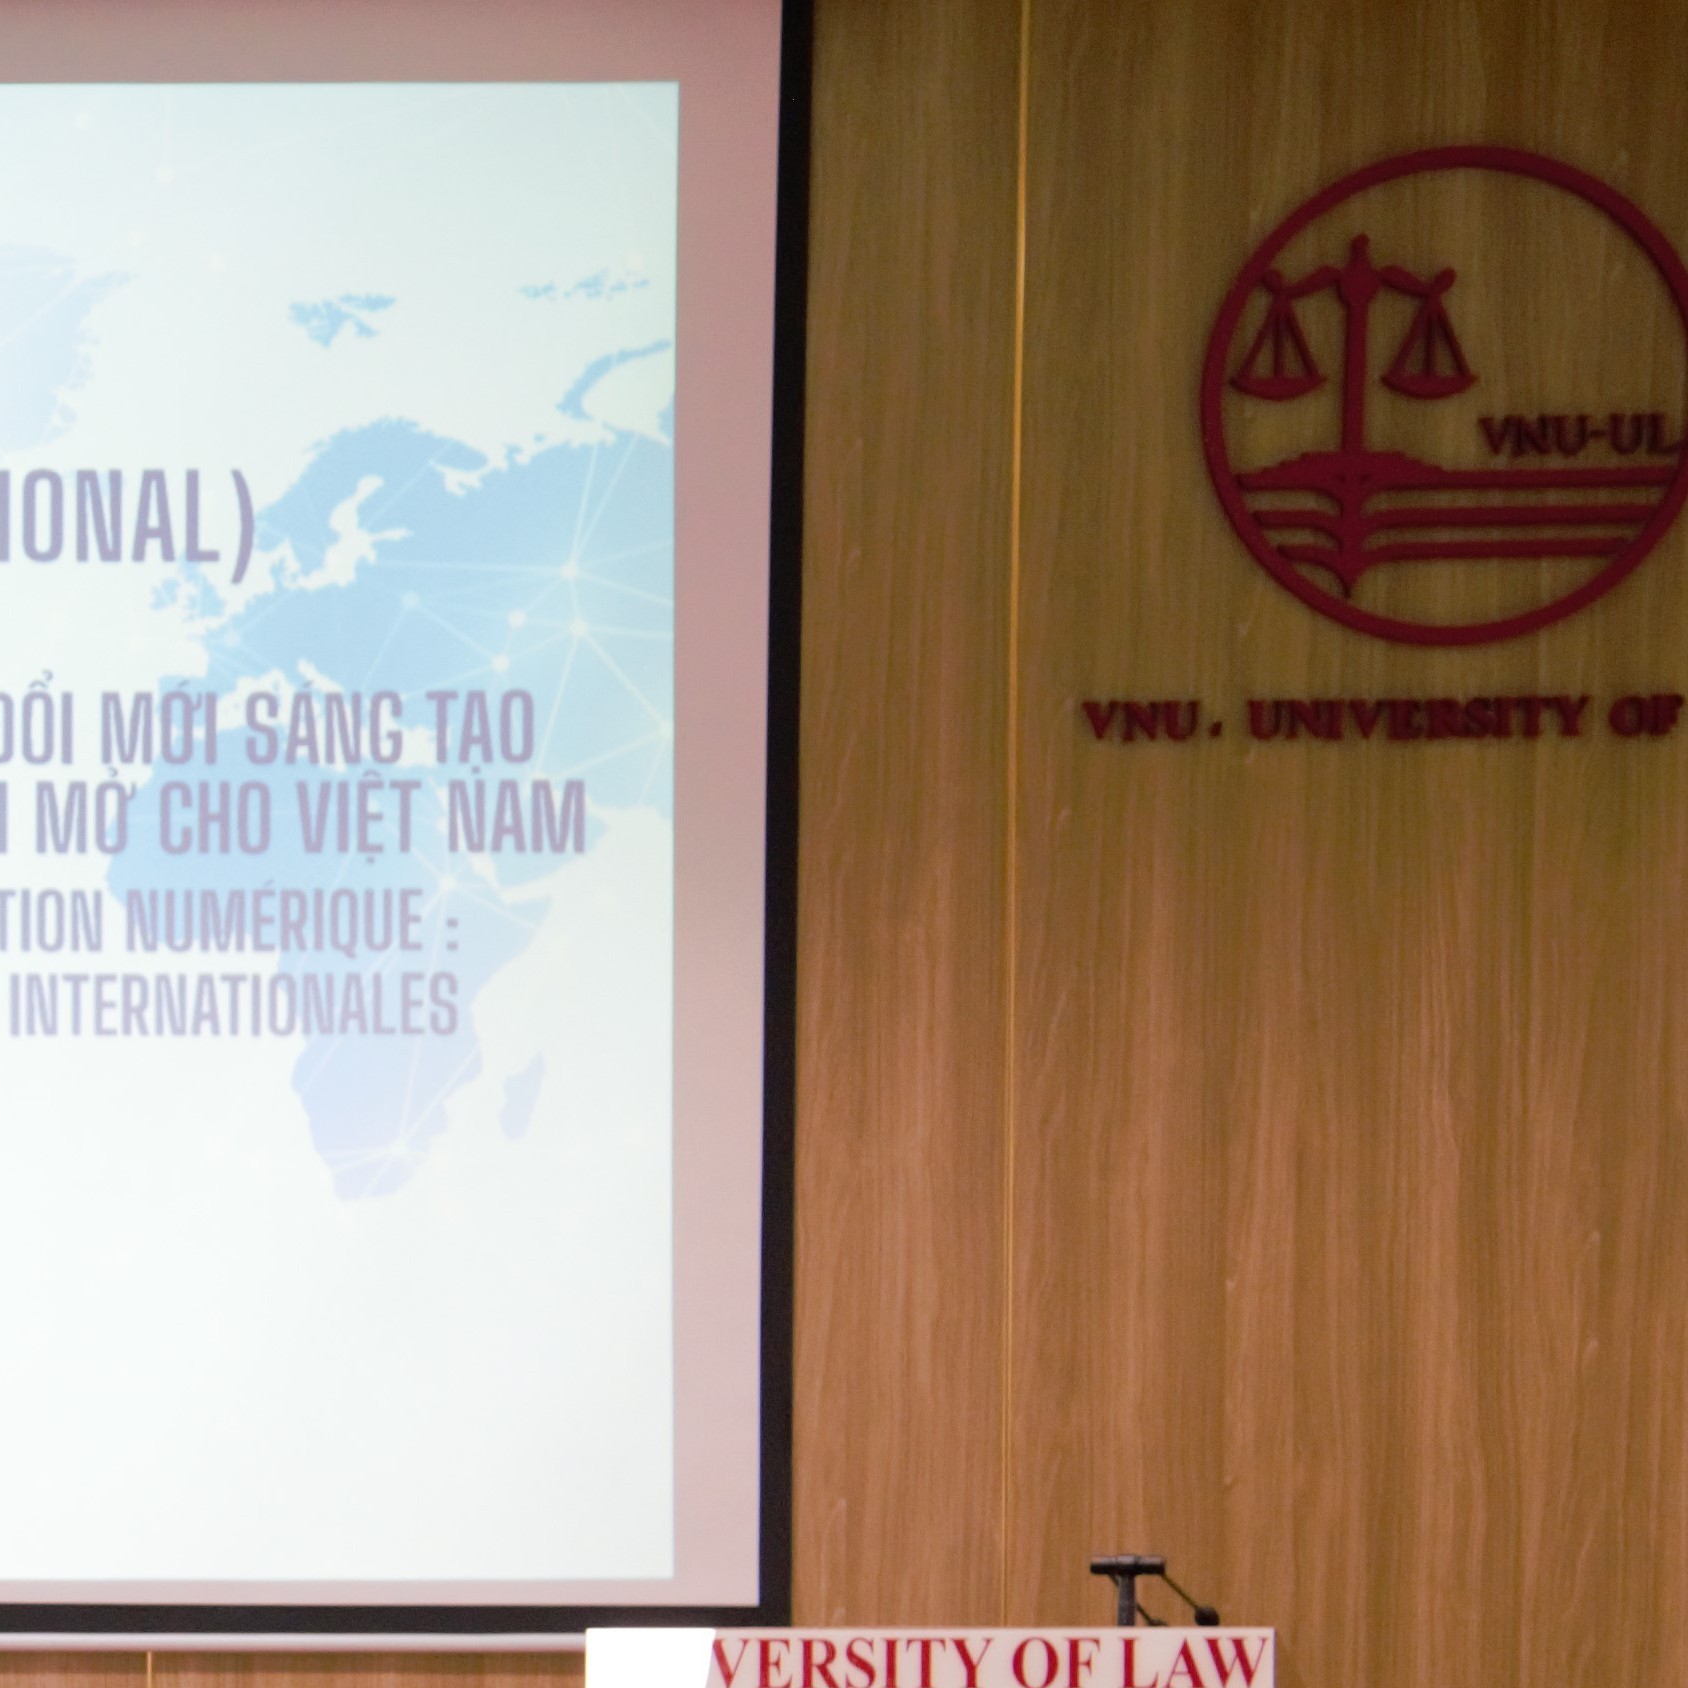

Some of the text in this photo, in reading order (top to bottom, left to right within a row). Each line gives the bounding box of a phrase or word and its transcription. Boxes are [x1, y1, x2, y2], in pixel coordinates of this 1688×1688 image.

[1477, 412, 1680, 457] VNU-UL
[101, 680, 218, 766] MỚI
[244, 680, 403, 766] SÁNG
[427, 690, 536, 775] TẠO
[1248, 694, 1589, 741] UNIVERSITY
[1608, 693, 1685, 738] OF
[35, 766, 138, 855] MỞ
[158, 779, 271, 856] CHO
[298, 771, 422, 863] VIỆT
[448, 779, 587, 856] NAM
[127, 878, 423, 959] NUMÉRIQUE
[9, 972, 460, 1037] INTERNATIONALES
